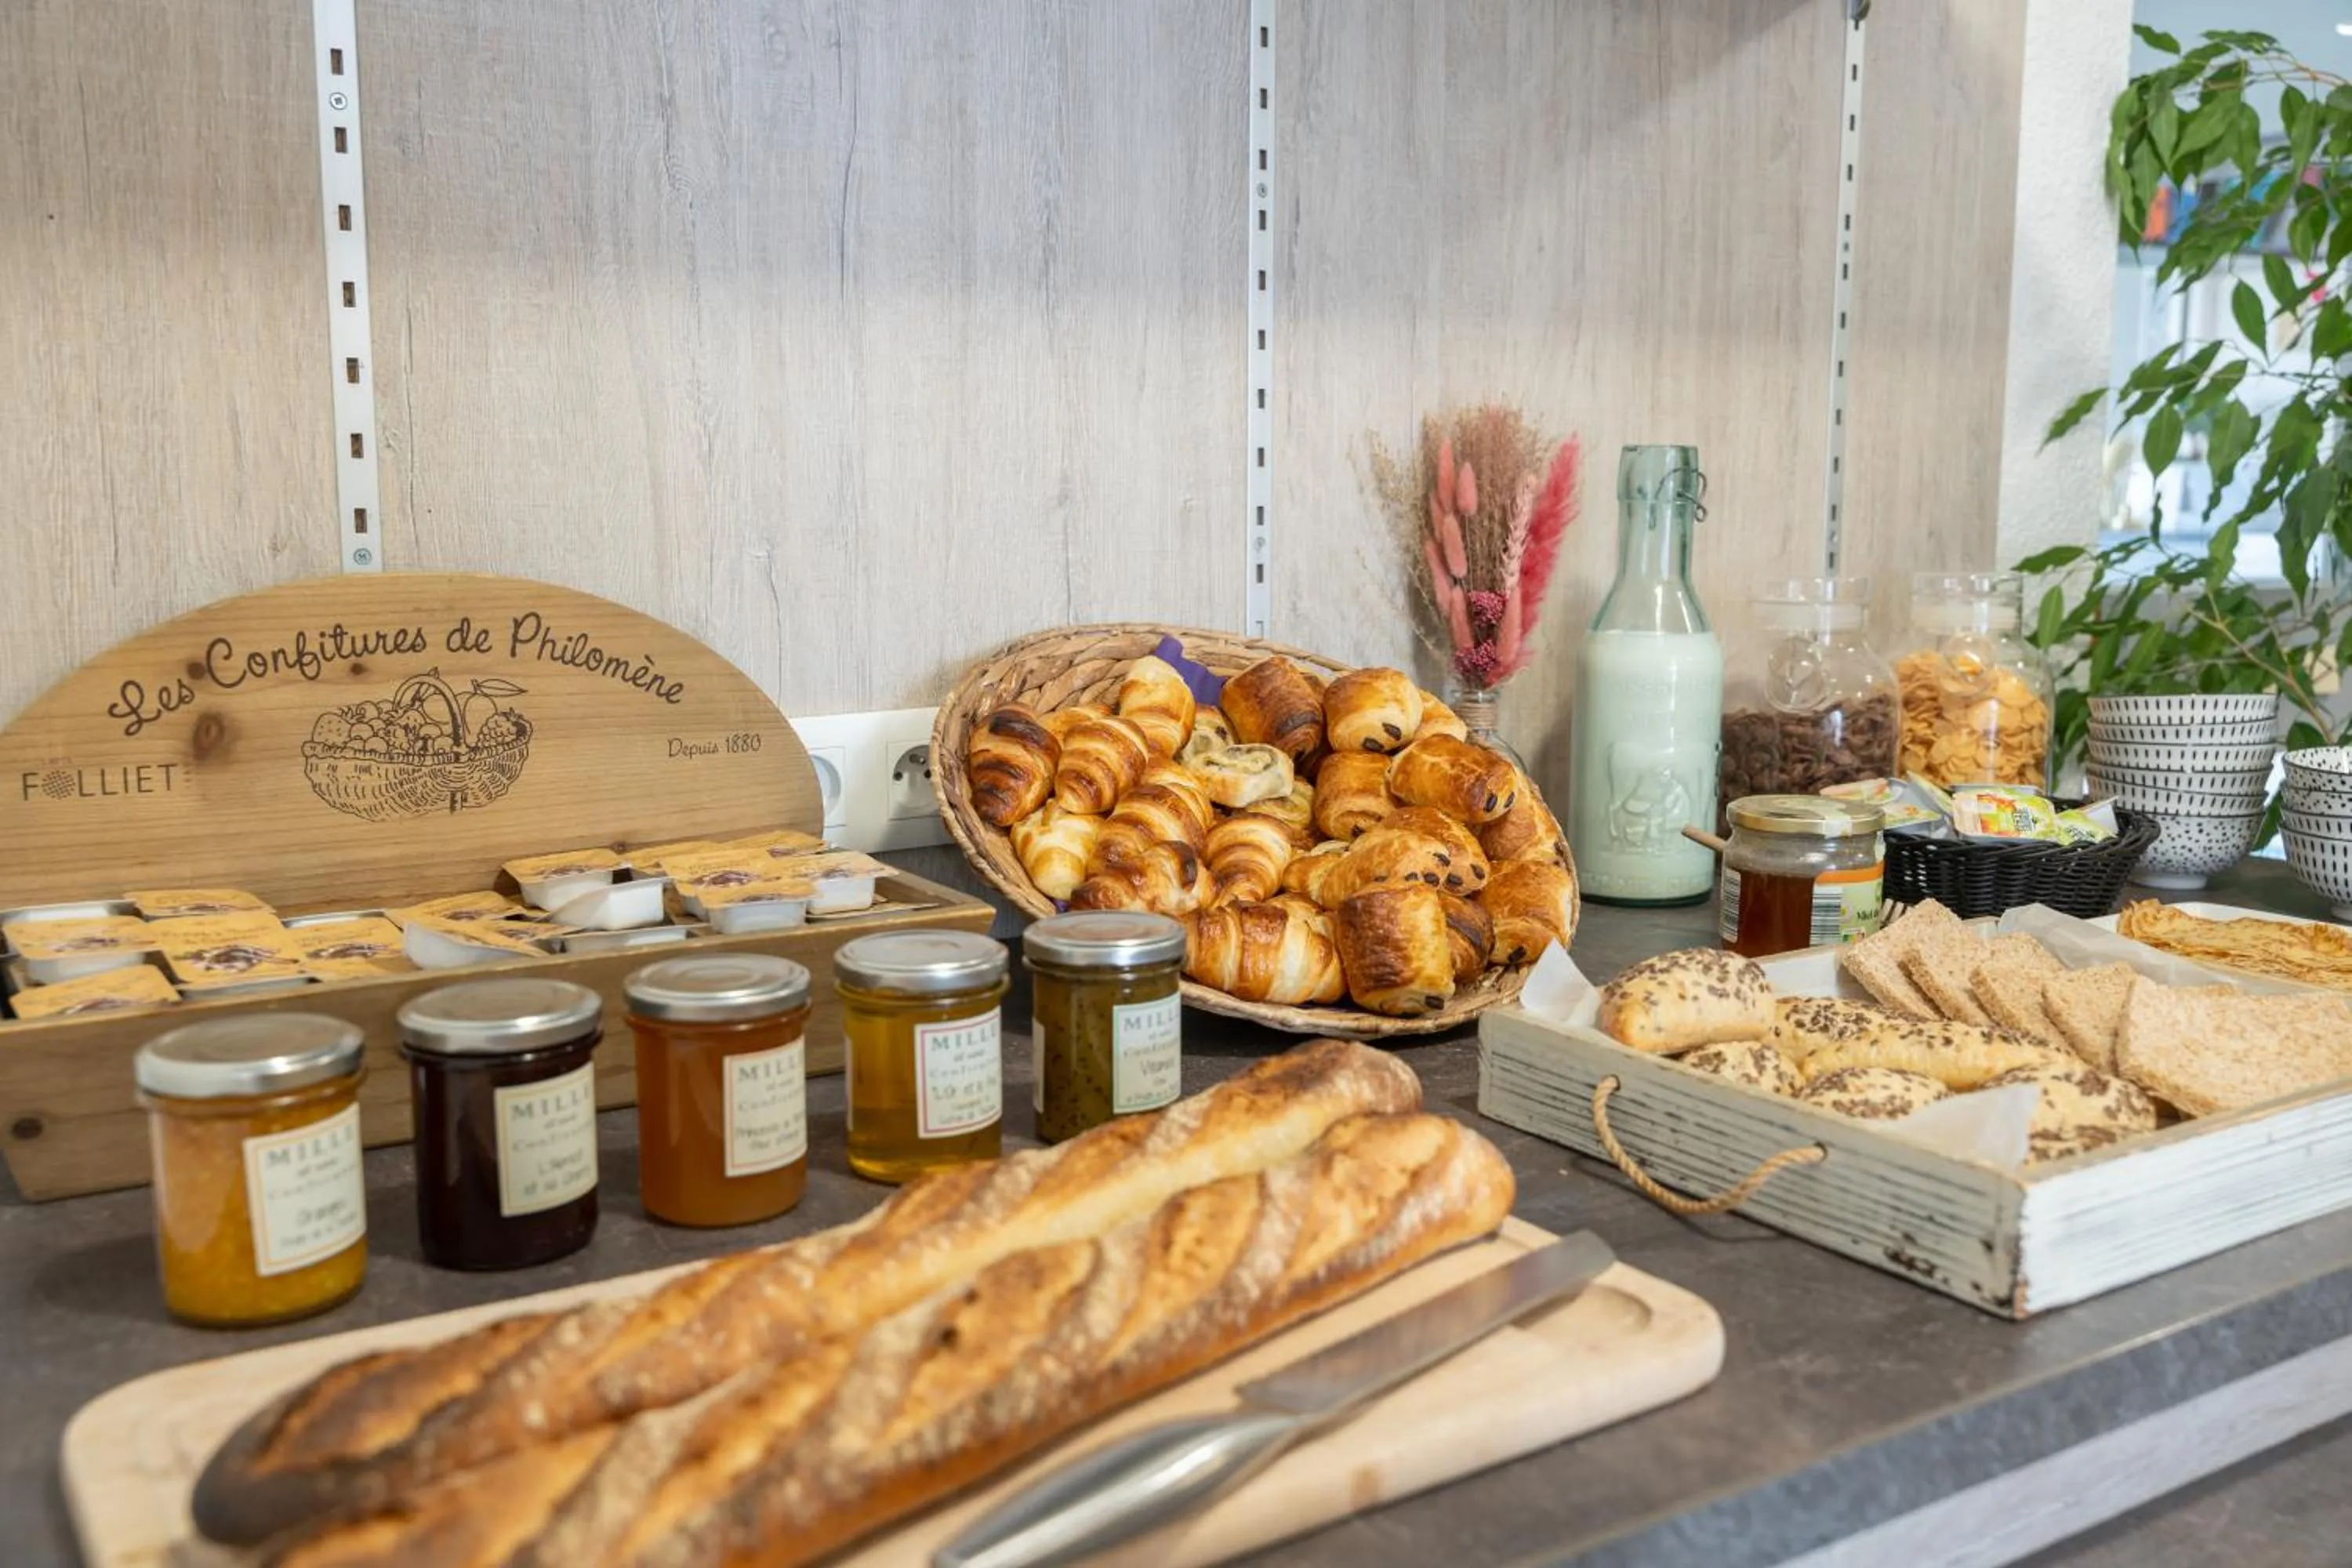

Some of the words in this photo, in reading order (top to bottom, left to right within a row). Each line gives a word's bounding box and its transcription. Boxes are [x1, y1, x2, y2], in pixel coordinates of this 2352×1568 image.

[108, 678, 195, 736] Les
[205, 623, 427, 688] Confitures
[446, 617, 492, 653] de
[510, 612, 685, 704] Philomène
[667, 738, 720, 760] Depuis
[725, 733, 761, 753] 1880
